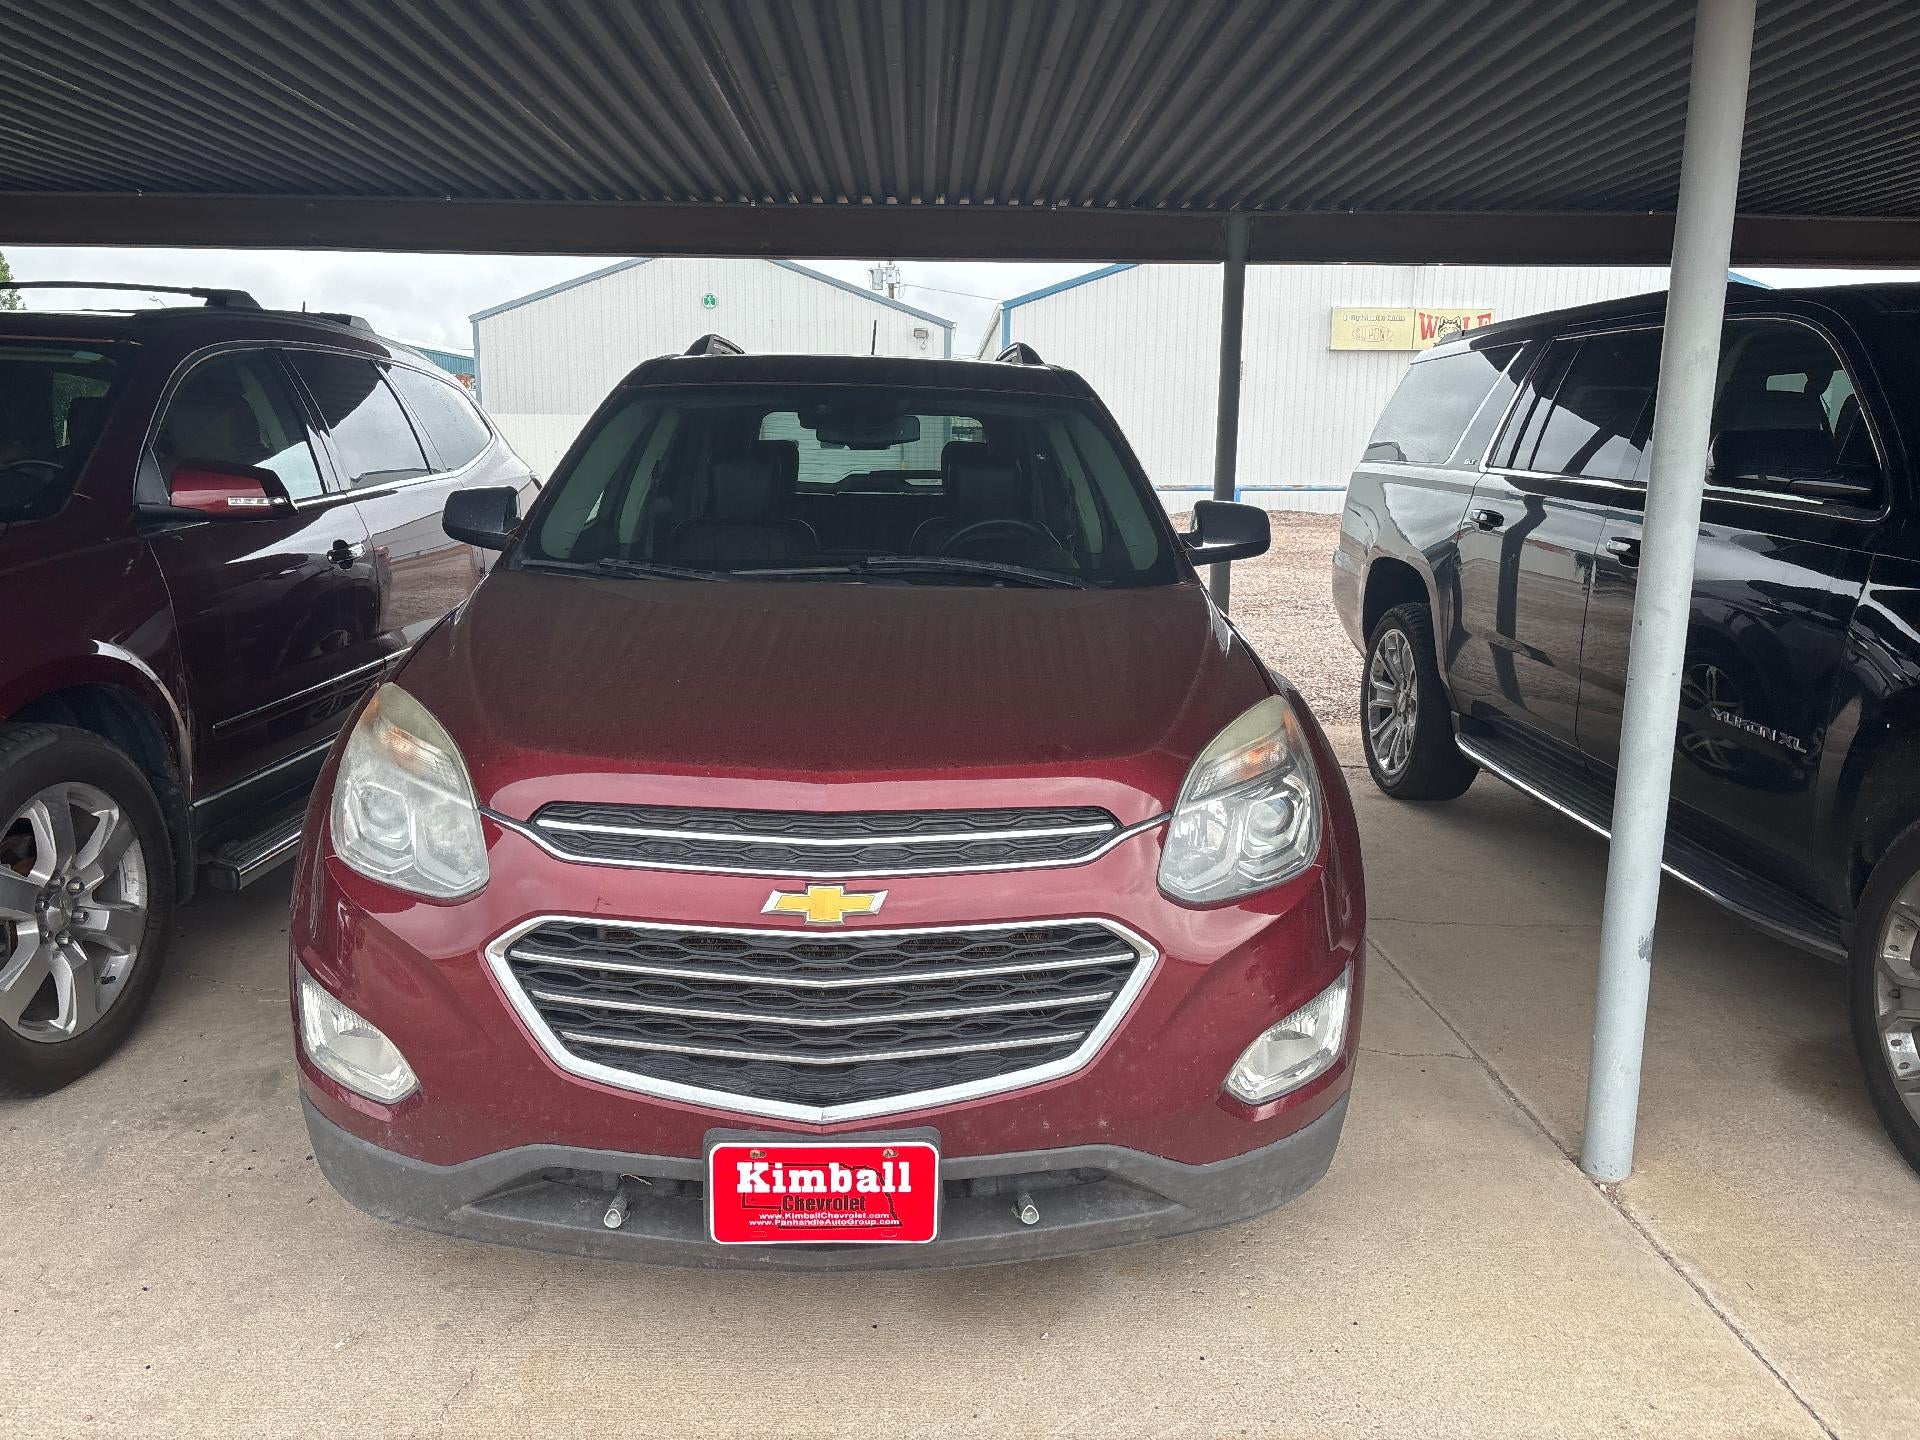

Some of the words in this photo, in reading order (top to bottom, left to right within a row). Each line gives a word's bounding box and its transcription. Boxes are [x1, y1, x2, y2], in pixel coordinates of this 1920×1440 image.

[1419, 312, 1491, 340] WLF
[1778, 731, 1807, 754] XL
[736, 1161, 912, 1193] Kimball
[782, 1195, 866, 1211] Chevrolet
[749, 1219, 900, 1227] www.PanhandleAutoGroup.com
[759, 1212, 890, 1220] www.KimballChevrolet.com
